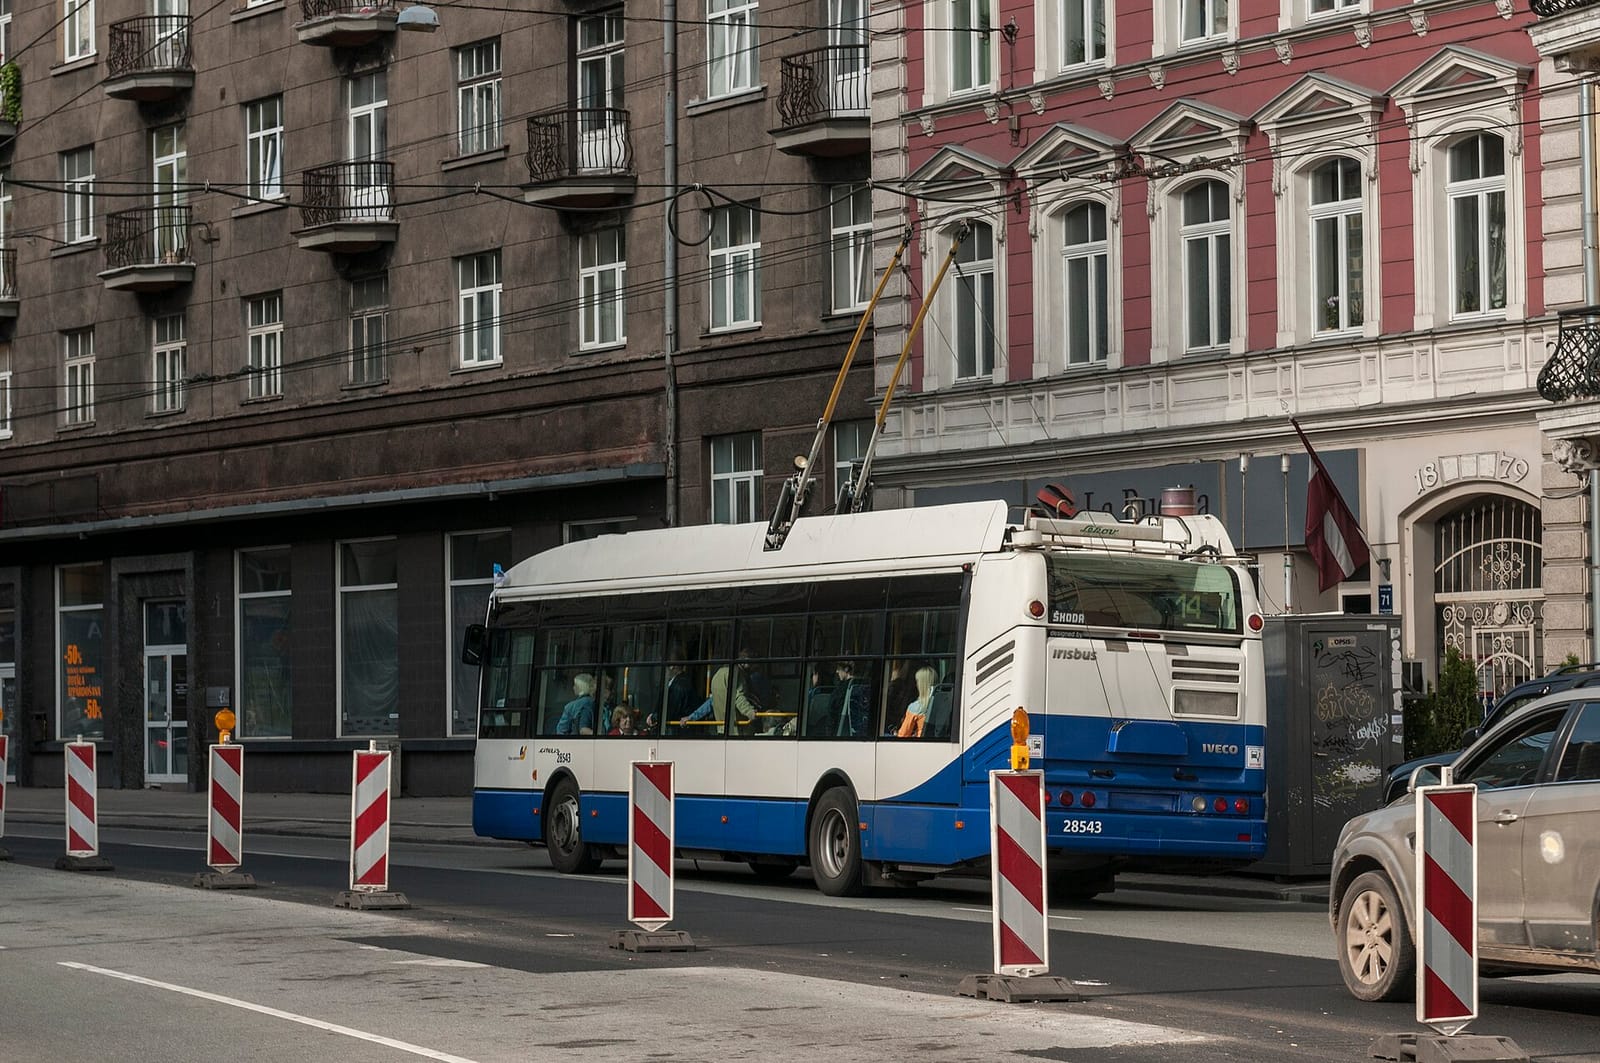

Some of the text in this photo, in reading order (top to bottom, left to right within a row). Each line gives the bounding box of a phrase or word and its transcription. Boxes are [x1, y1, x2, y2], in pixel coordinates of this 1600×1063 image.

[1175, 592, 1201, 619] 14
[1381, 594, 1390, 606] 71
[1053, 610, 1085, 623] ŠKODA
[1202, 743, 1239, 755] IVECO
[557, 752, 571, 763] 28543
[1063, 820, 1102, 834] 28543
